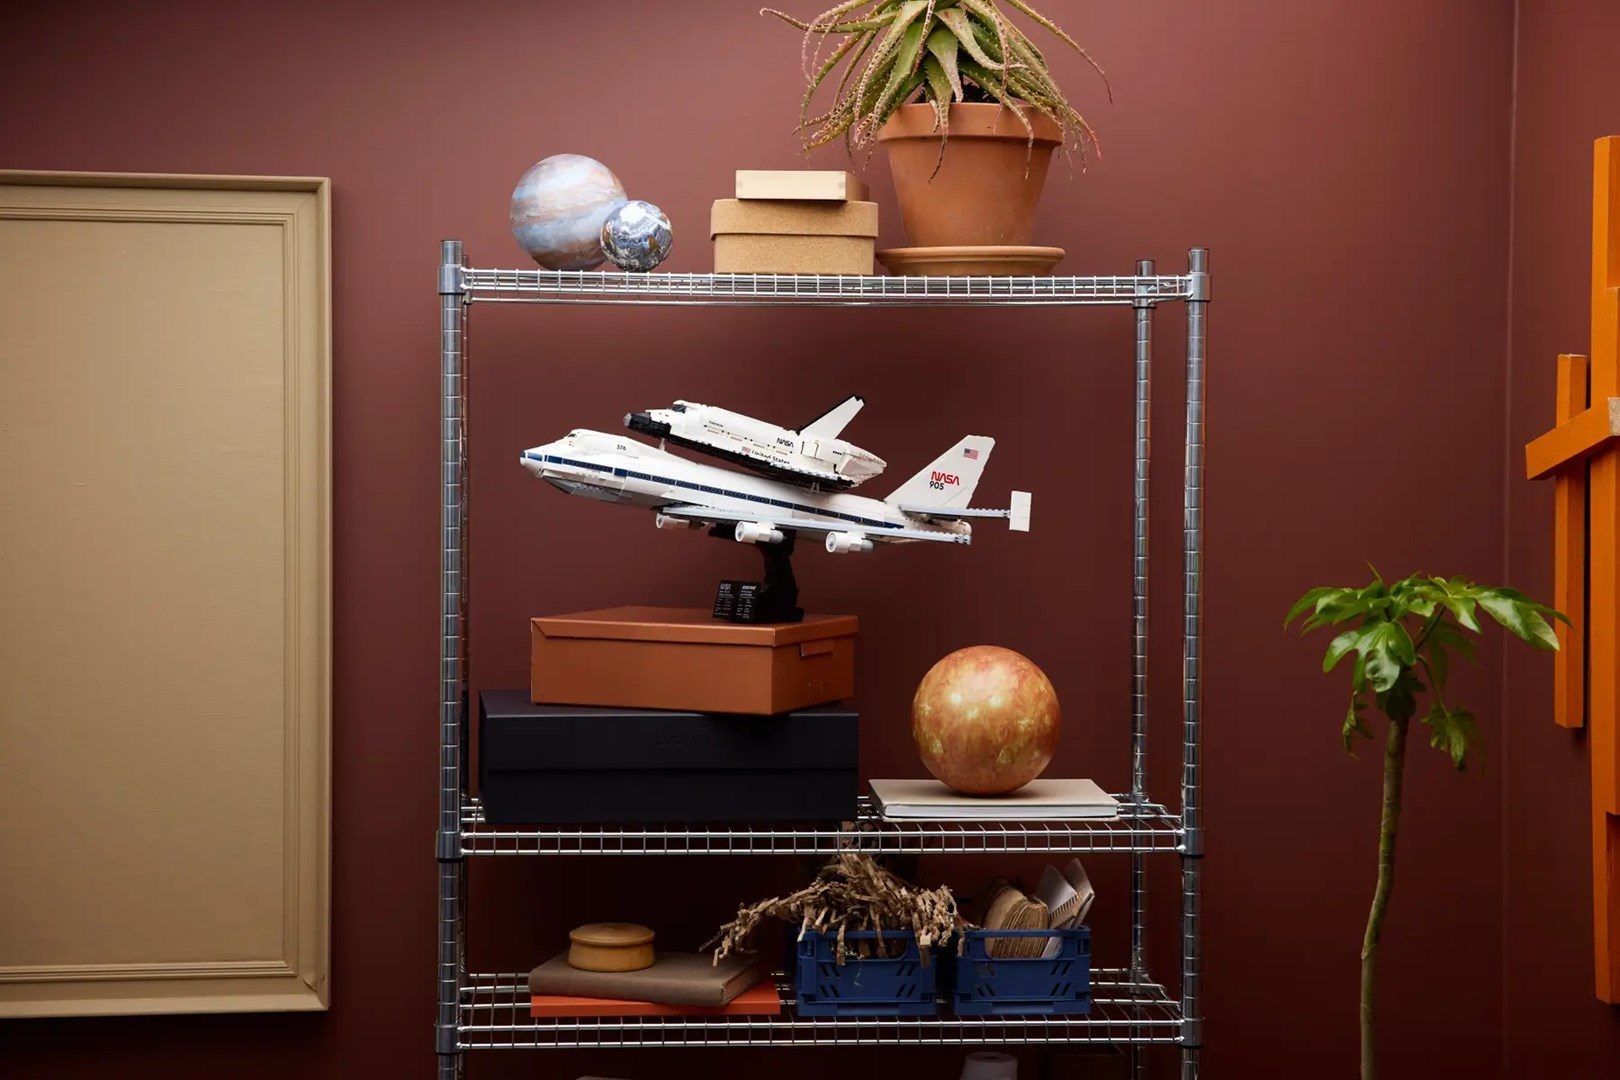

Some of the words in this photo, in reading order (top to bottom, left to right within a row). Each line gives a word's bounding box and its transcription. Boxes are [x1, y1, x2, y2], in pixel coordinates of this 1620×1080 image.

[776, 437, 794, 448] NASA
[751, 449, 772, 459] United
[772, 456, 790, 465] States
[931, 471, 960, 486] NASA
[929, 480, 945, 491] 905
